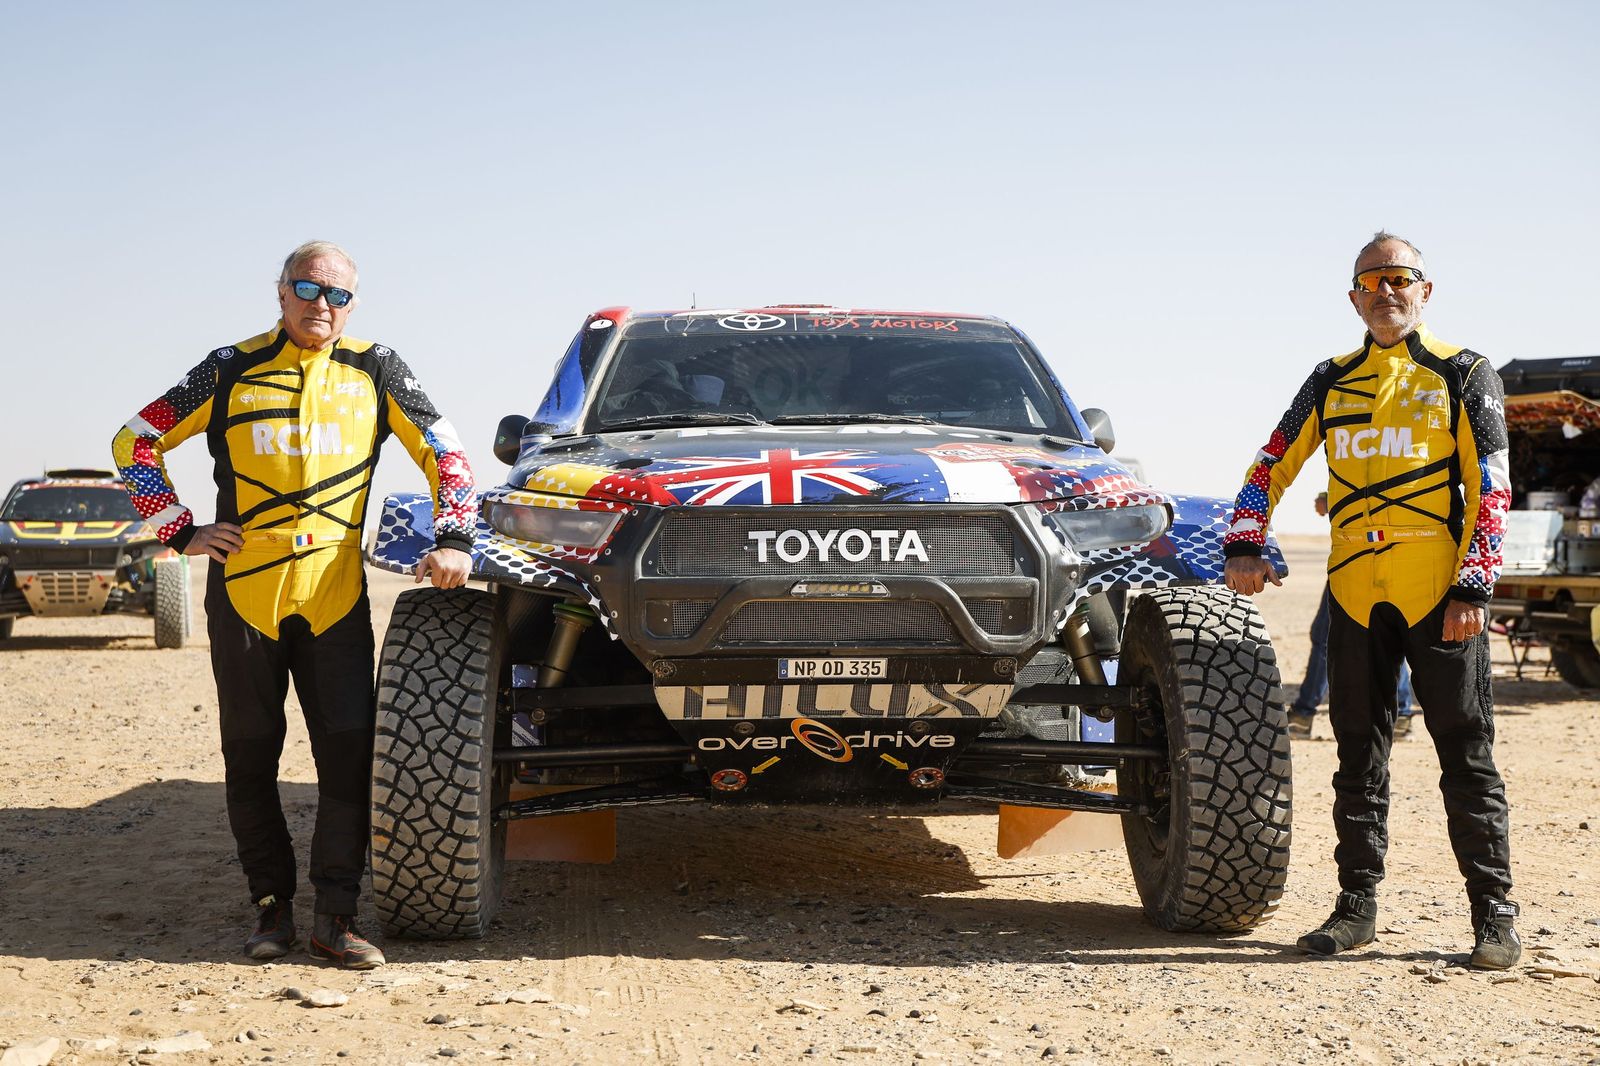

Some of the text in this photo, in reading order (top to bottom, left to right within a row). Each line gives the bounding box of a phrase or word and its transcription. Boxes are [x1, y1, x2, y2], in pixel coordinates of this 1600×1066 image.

[1334, 426, 1429, 460] RCM.
[748, 528, 930, 563] TOYOTA
[794, 661, 881, 676] NP OD 335
